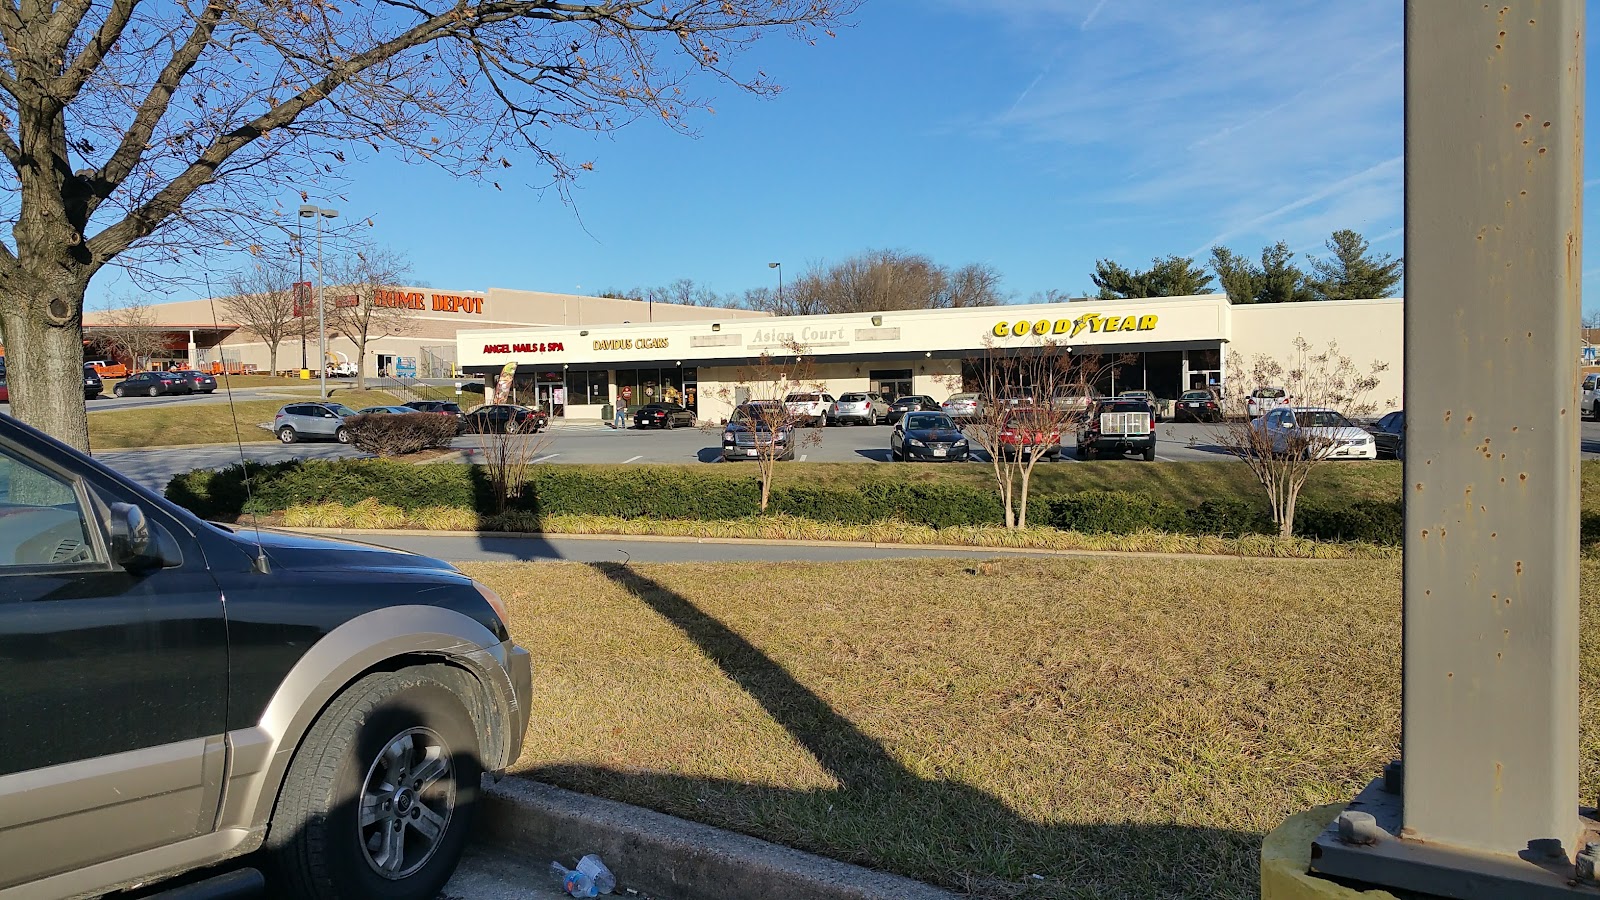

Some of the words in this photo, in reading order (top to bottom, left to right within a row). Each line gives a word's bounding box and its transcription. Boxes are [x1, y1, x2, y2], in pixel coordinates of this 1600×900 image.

[373, 289, 426, 310] HOME
[431, 294, 484, 314] DEPOT
[753, 328, 794, 343] Asian
[801, 326, 845, 341] Court
[483, 344, 511, 354] ANGEL
[513, 343, 537, 353] NAILS
[539, 343, 546, 353] &
[547, 342, 564, 352] SPA
[593, 339, 632, 351] DAVIDUS
[635, 337, 669, 349] CIGARS
